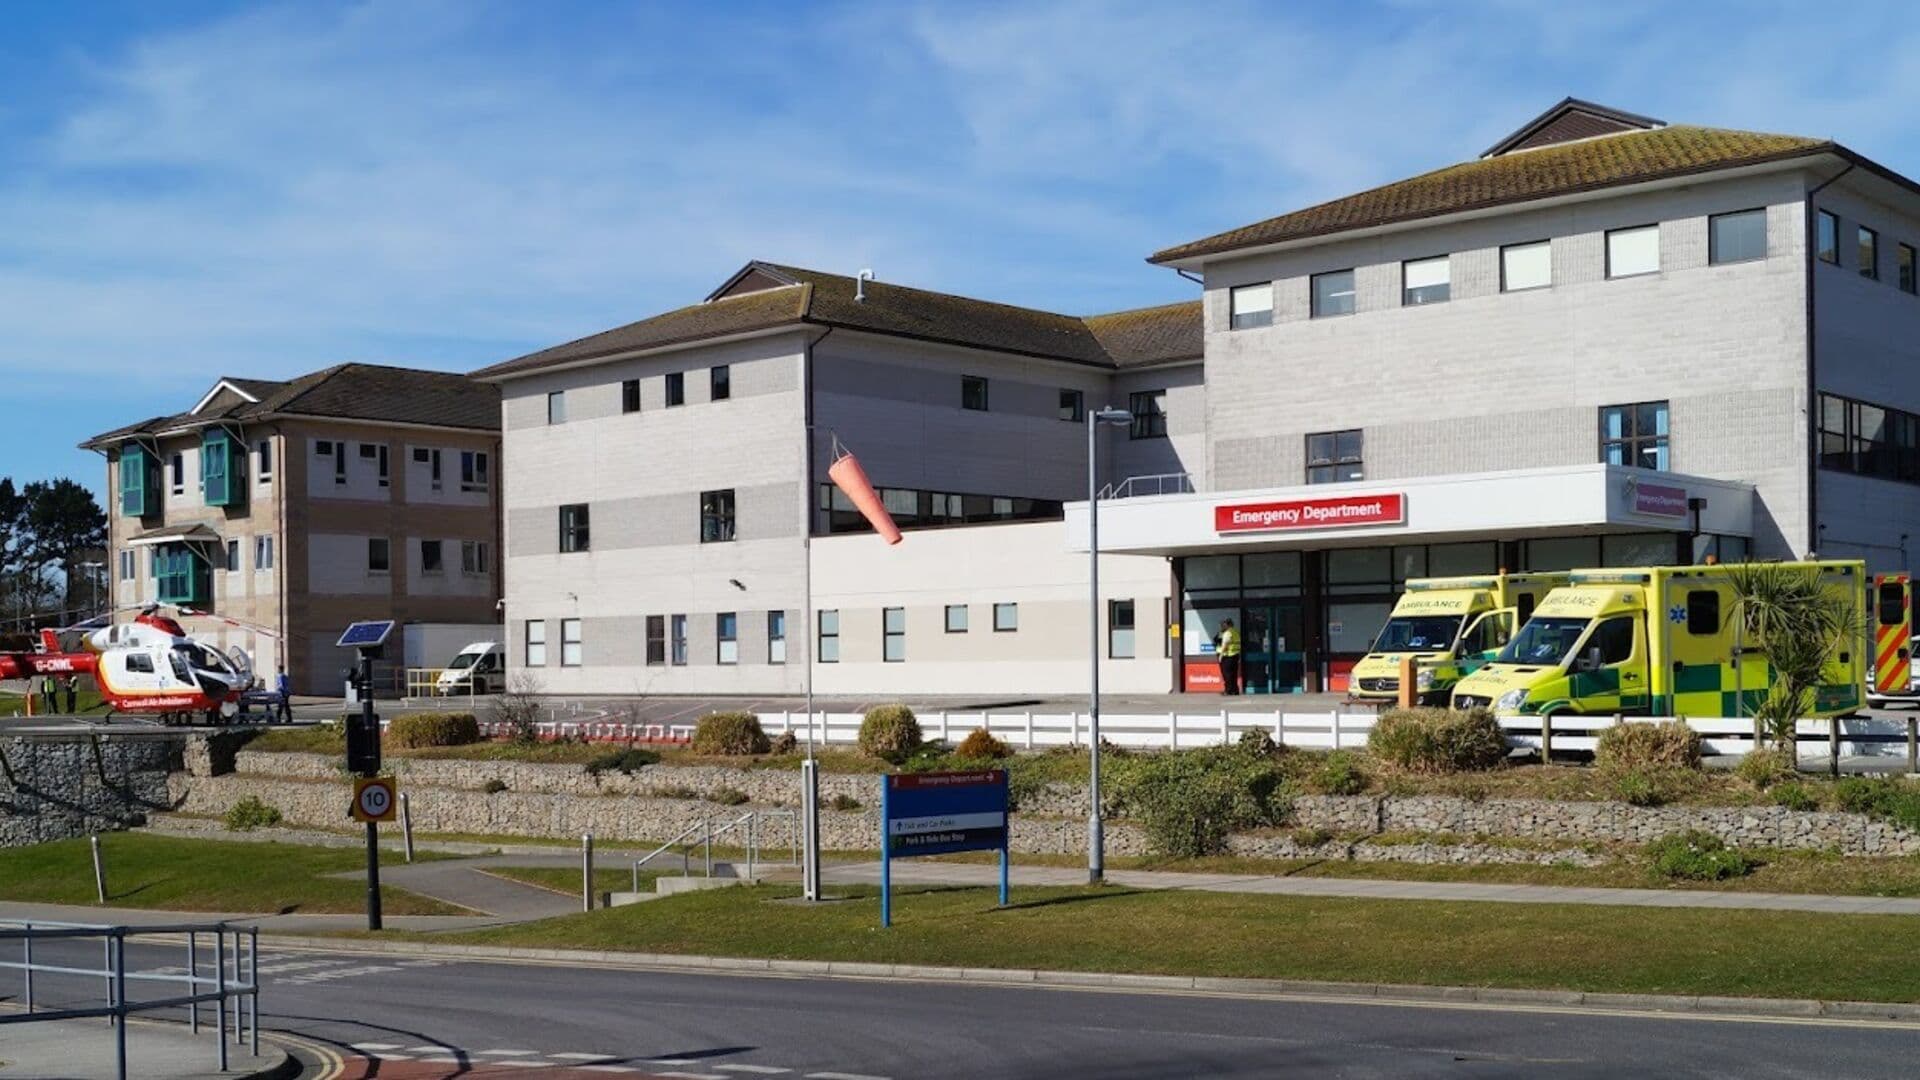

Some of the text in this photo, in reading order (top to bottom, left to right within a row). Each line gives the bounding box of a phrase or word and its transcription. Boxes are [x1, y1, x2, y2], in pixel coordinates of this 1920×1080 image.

[1232, 501, 1382, 525] Emergency Department
[1400, 600, 1462, 610] AMBULANCE
[366, 791, 385, 807] 10
[905, 836, 919, 845] Park
[926, 834, 939, 843] Ride
[951, 833, 965, 842] Stop
